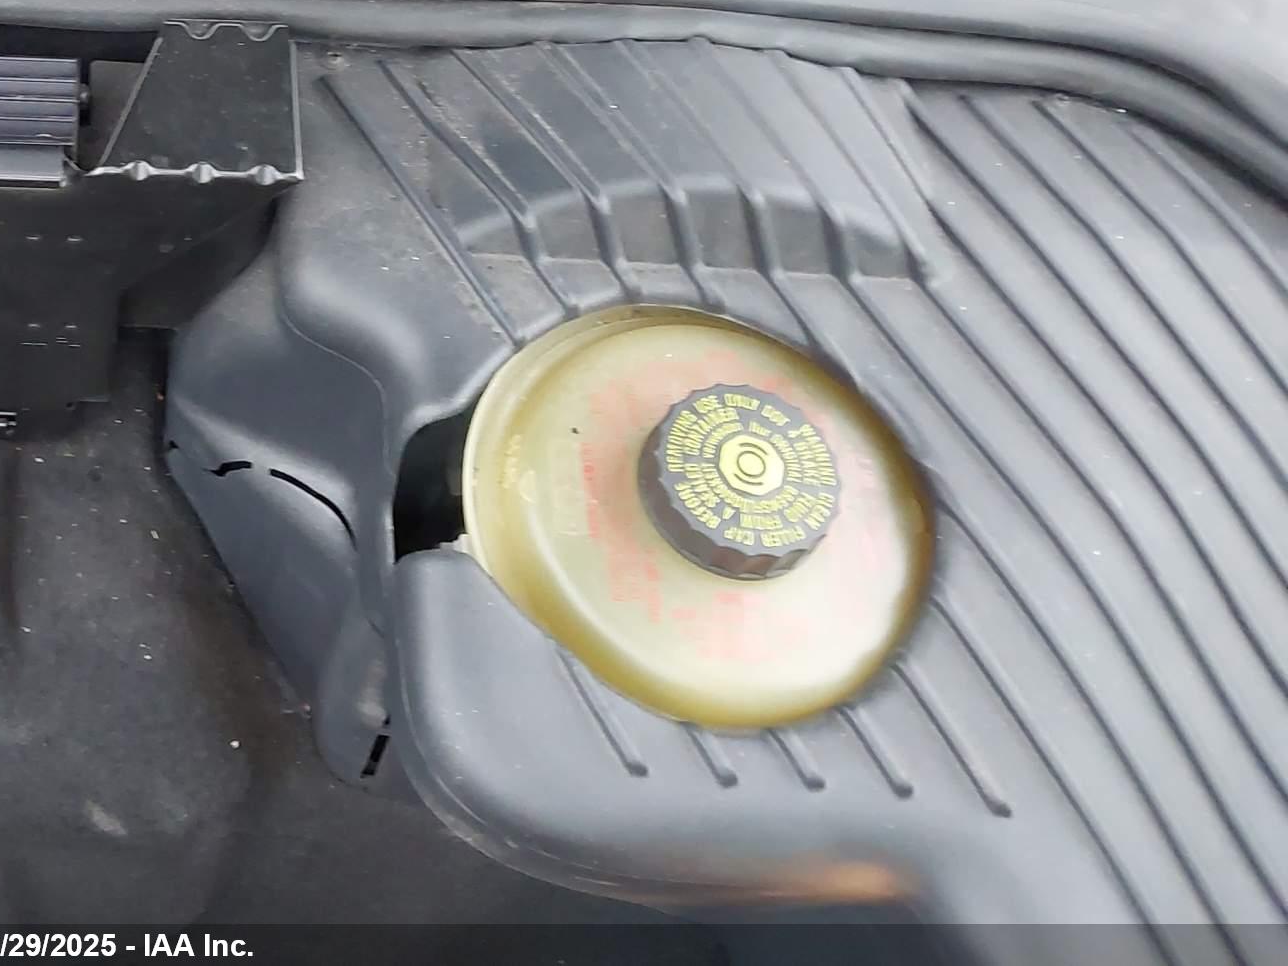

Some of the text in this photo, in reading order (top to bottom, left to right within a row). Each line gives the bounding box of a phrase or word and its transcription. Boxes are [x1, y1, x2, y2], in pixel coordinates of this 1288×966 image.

[693, 395, 719, 413] USE
[724, 394, 760, 410] ONLY
[761, 405, 791, 426] DOT
[798, 424, 837, 486] WARNING
[675, 480, 721, 529] BEFORE
[804, 493, 835, 530] CLEAN
[724, 528, 755, 545] CAP
